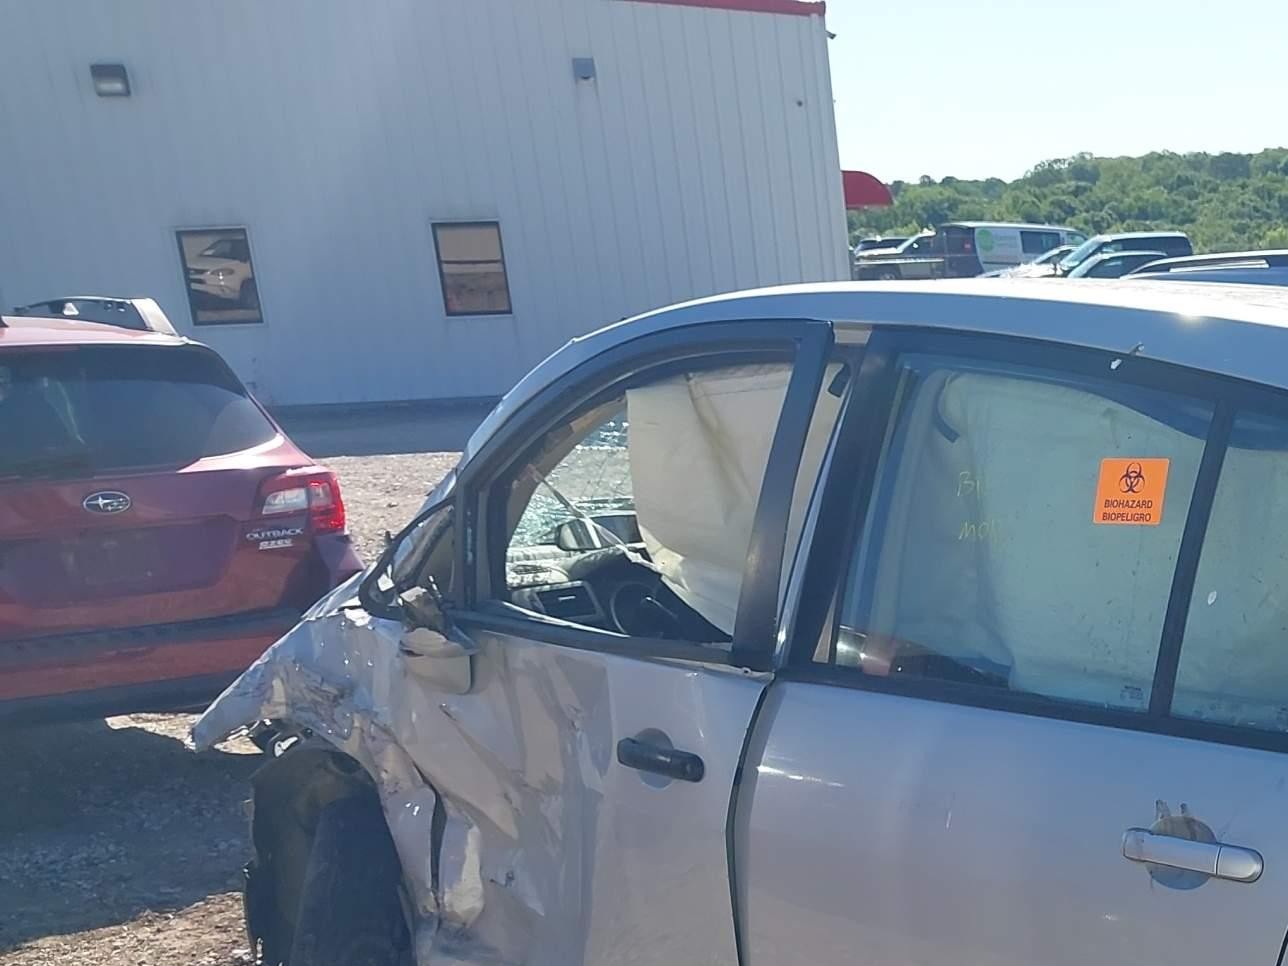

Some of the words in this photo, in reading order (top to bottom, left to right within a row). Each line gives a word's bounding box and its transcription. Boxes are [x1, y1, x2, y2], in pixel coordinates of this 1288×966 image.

[1104, 499, 1153, 509] BIOHAZARD
[1102, 512, 1152, 522] BIOPELIGRO
[245, 527, 304, 540] OUTBACK
